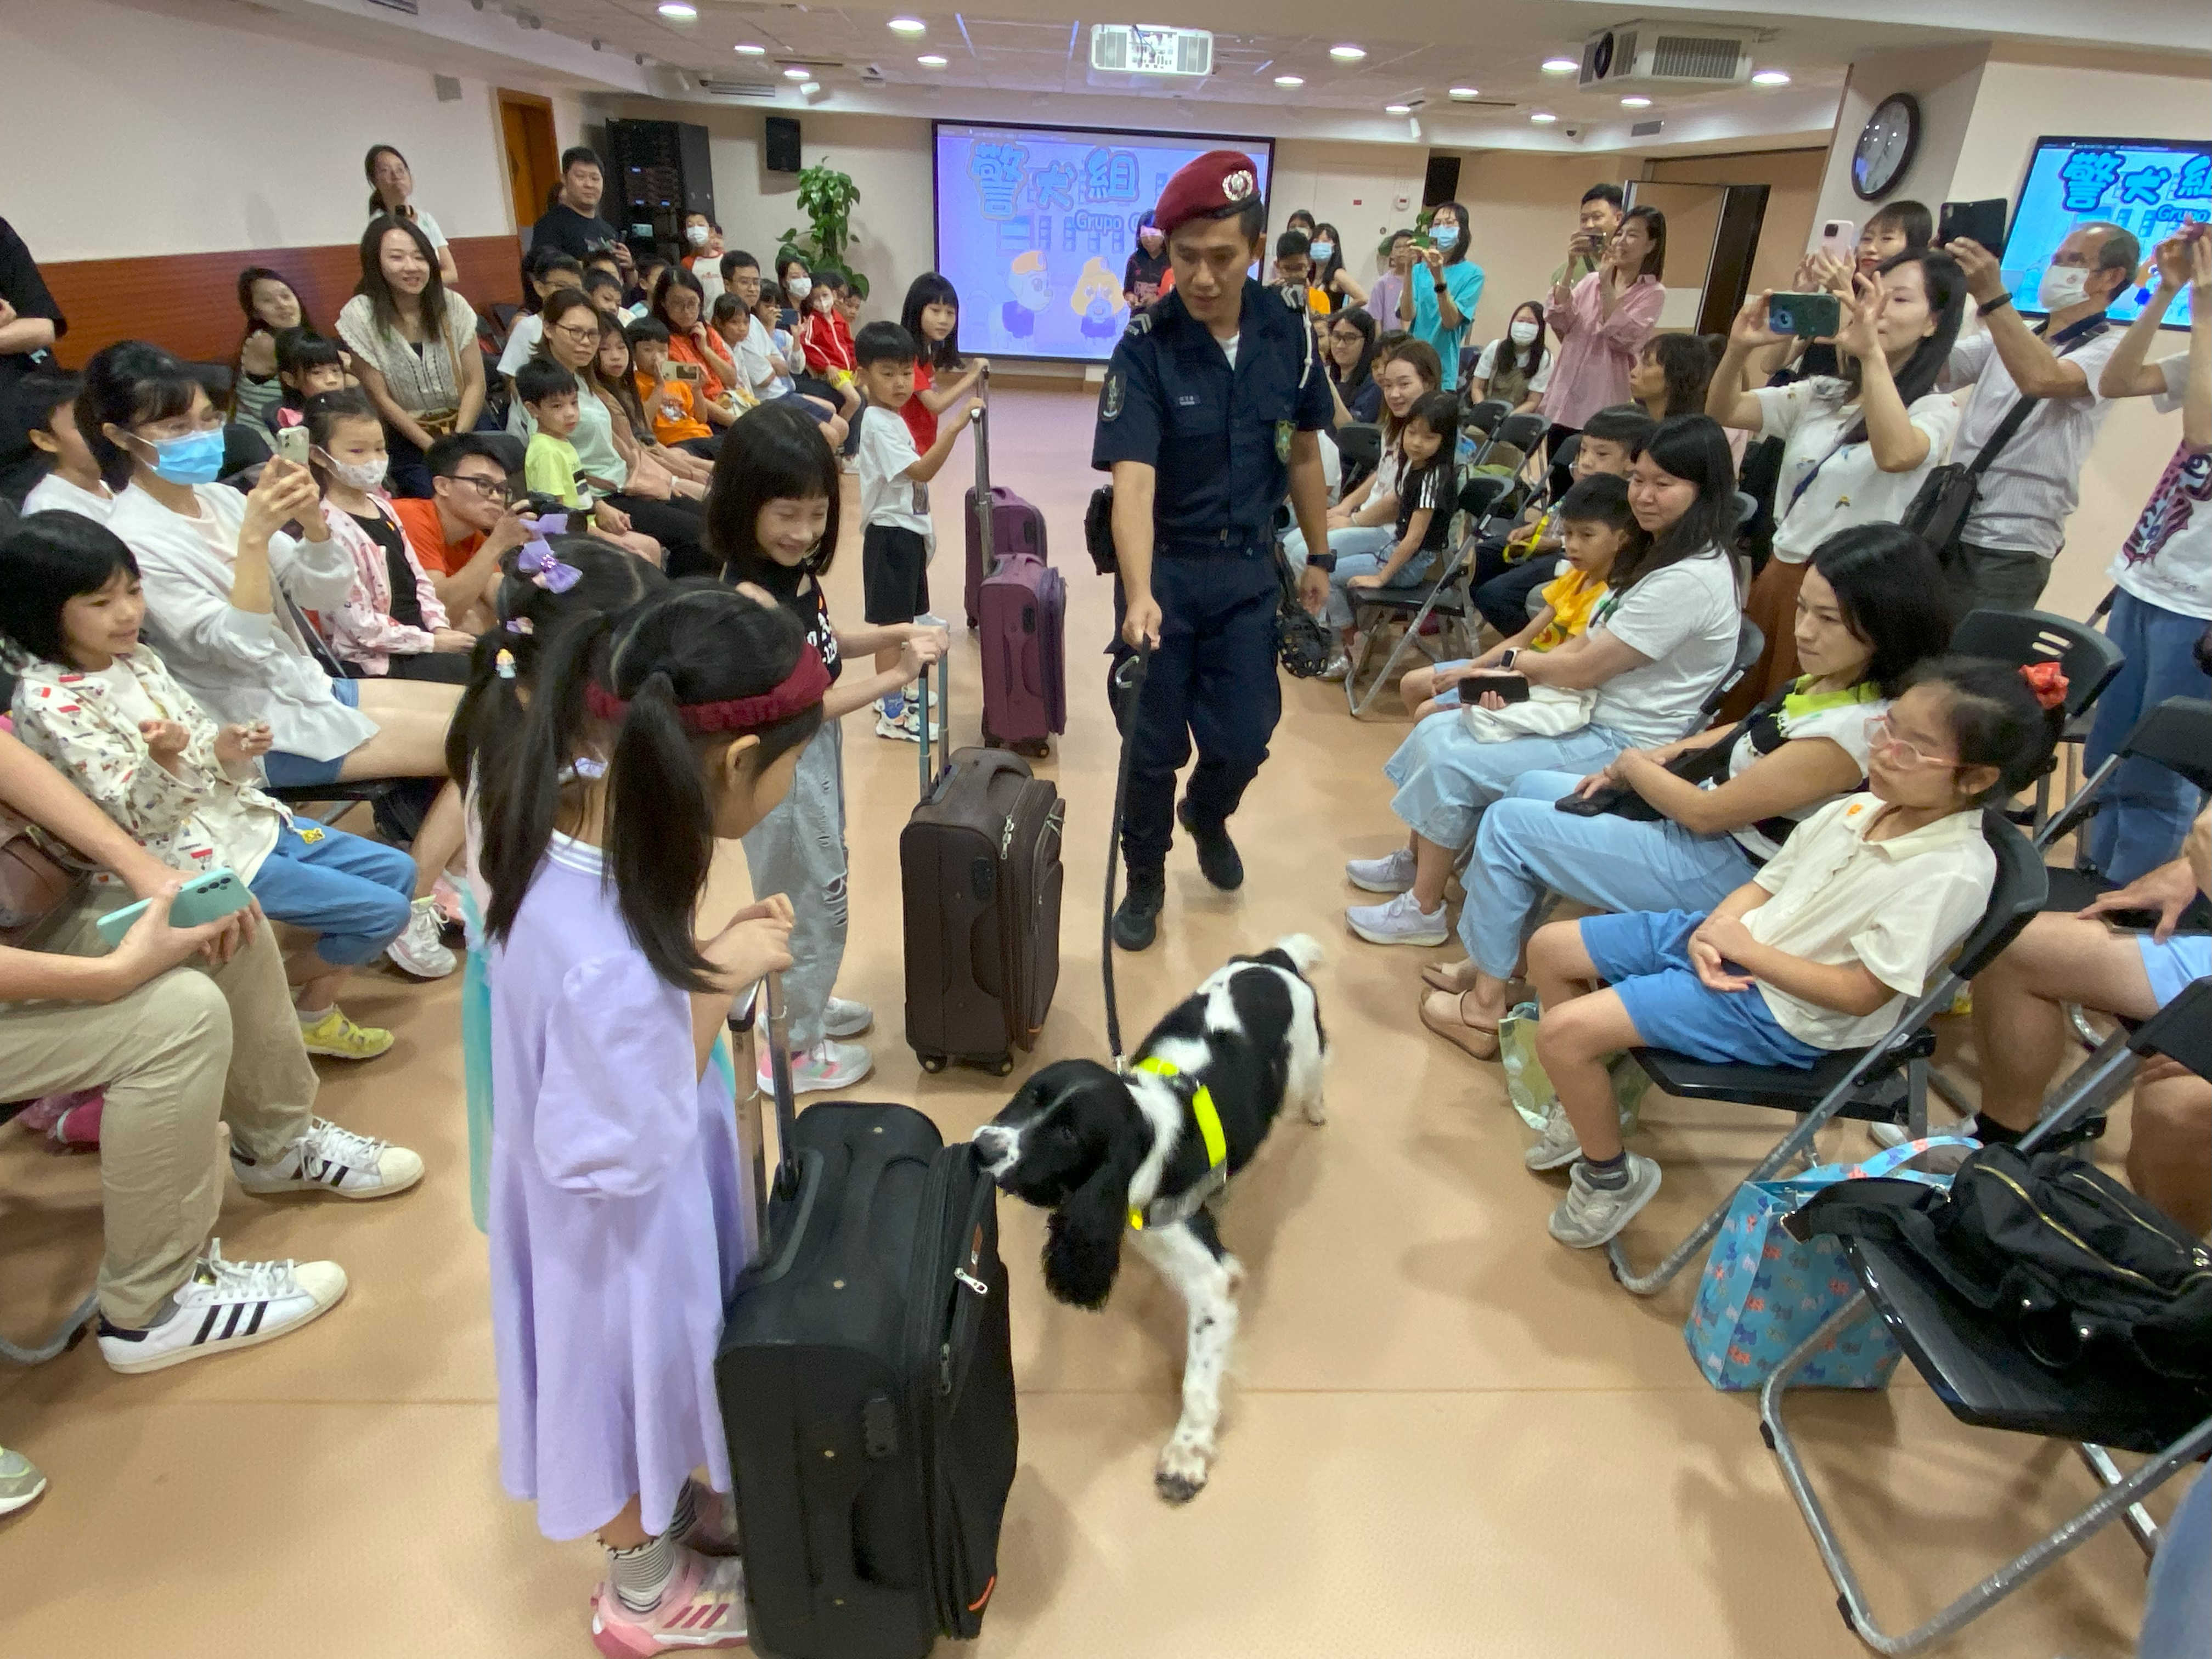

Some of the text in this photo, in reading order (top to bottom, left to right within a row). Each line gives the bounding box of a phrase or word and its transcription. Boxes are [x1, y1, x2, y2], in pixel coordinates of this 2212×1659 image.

[968, 140, 1139, 218] 警犬組
[1076, 210, 1123, 236] Grupo
